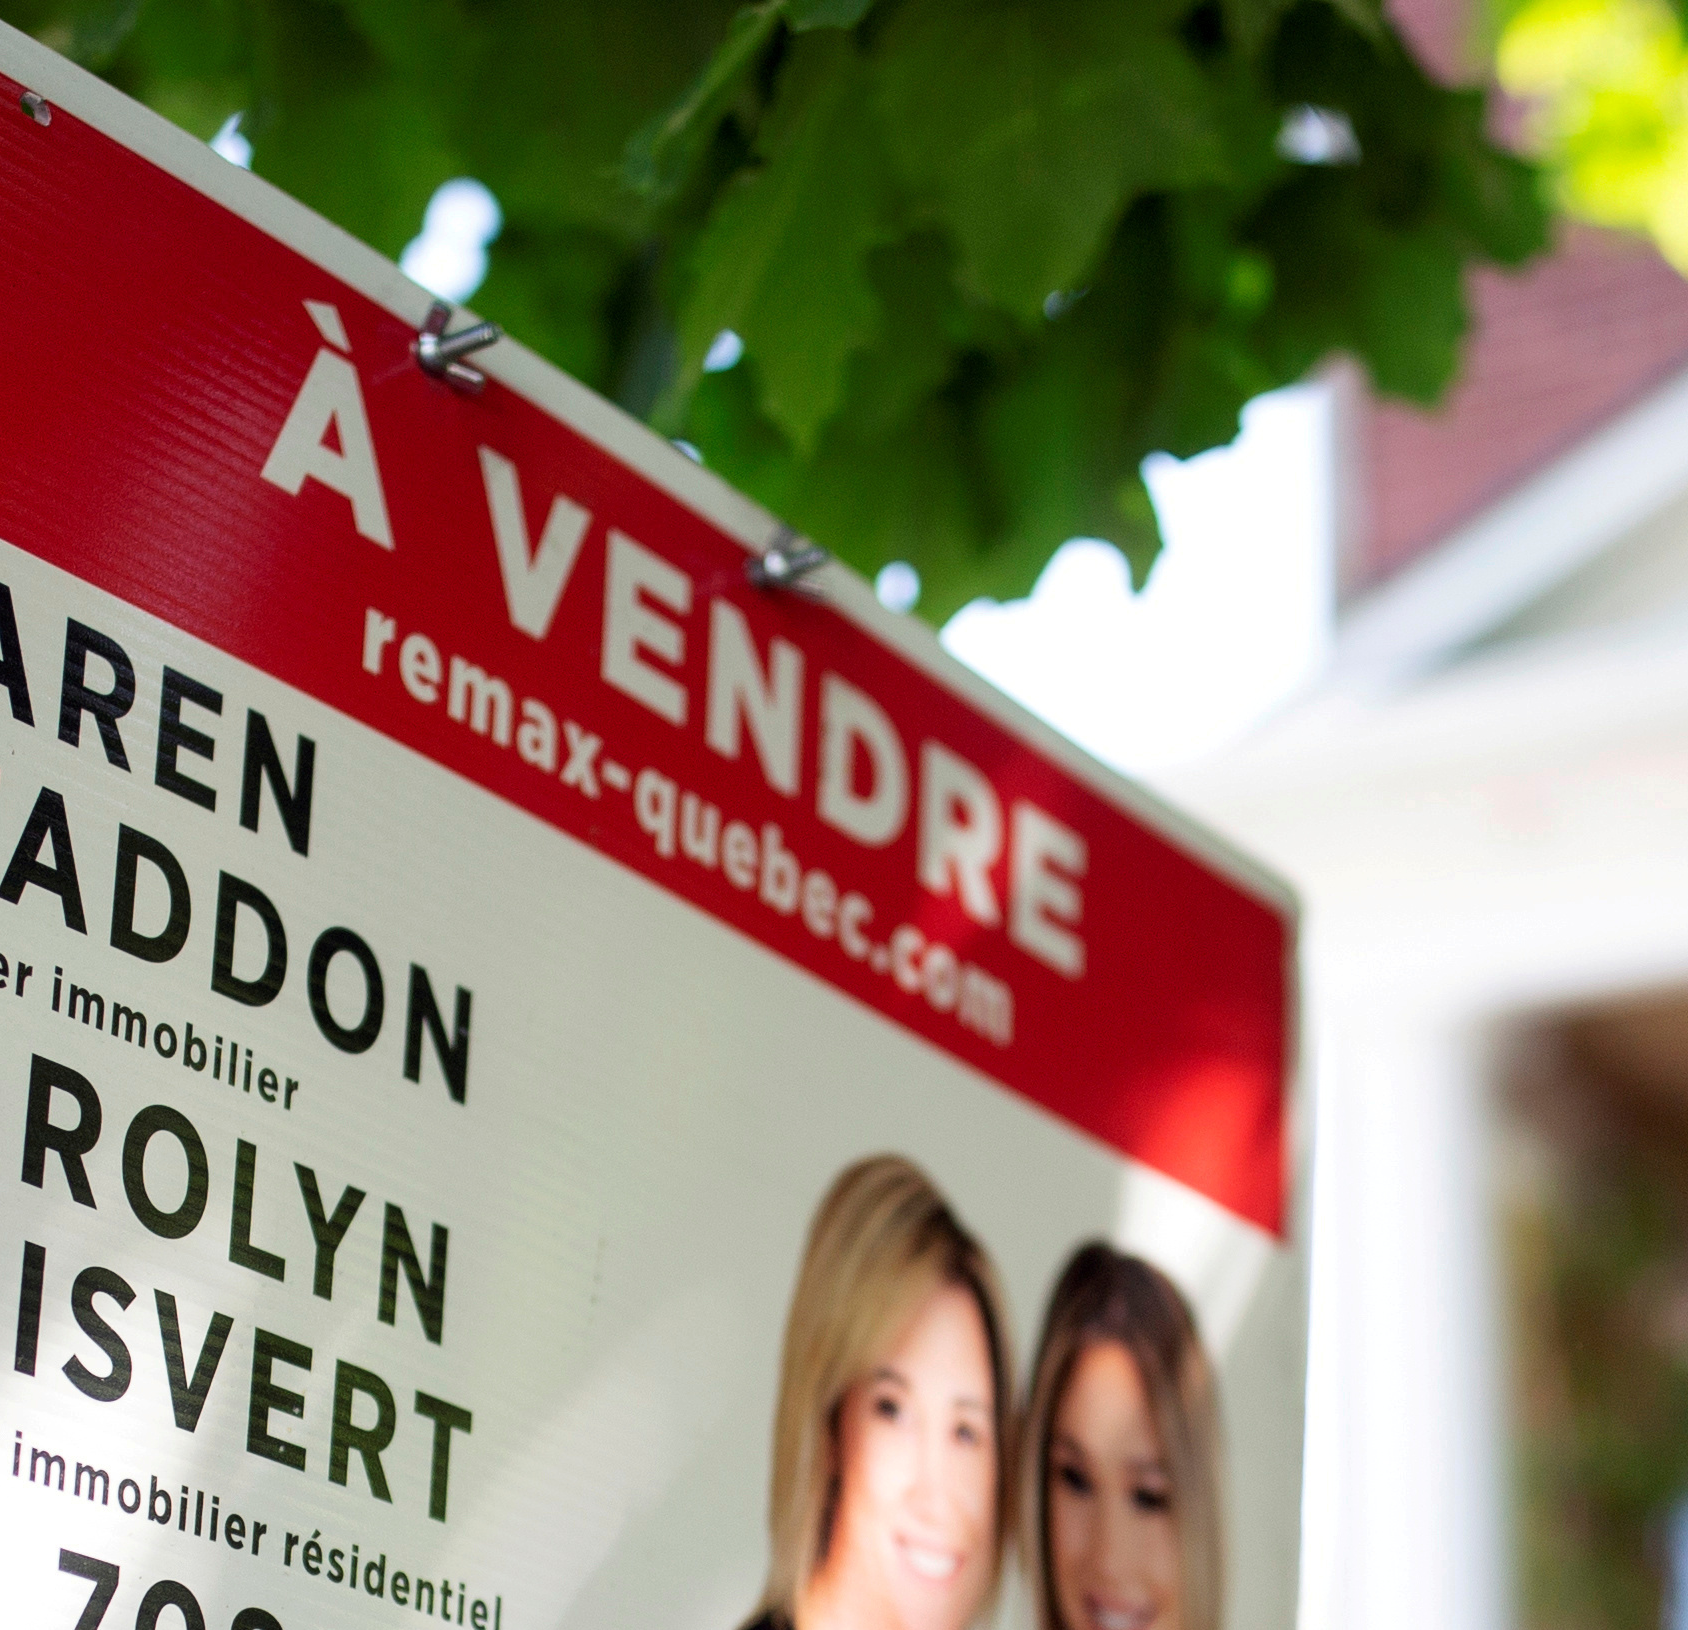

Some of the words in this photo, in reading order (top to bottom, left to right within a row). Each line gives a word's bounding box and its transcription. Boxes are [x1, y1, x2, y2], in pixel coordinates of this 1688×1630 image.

[261, 299, 395, 550] À
[478, 447, 1089, 977] VENDRE
[361, 608, 1013, 1047] remax-quebec.com
[52, 964, 300, 1112] immobilier
[12, 1430, 269, 1557] immobilier
